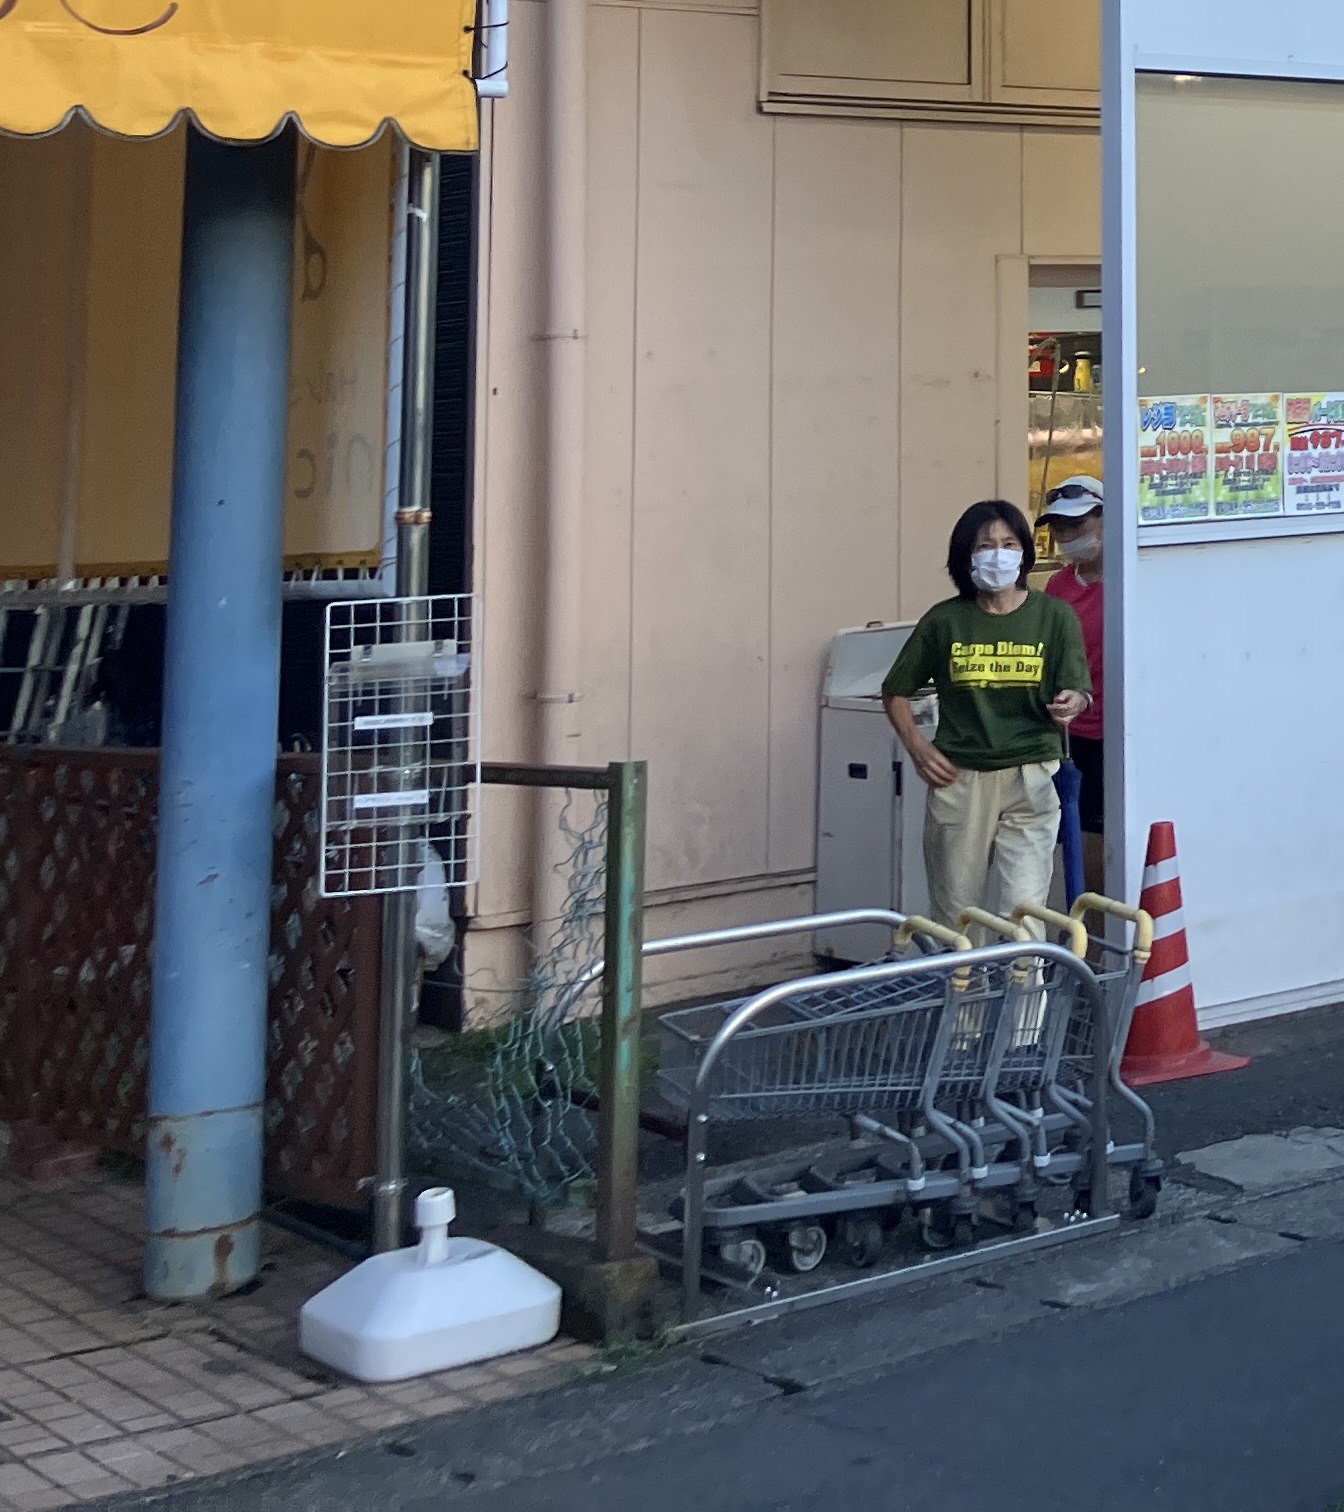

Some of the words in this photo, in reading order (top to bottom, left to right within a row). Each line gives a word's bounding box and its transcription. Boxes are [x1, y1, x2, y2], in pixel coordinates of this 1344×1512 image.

[951, 641, 994, 658] Carpe
[997, 641, 1044, 657] Diem!
[952, 660, 985, 674] Seize
[989, 660, 1011, 673] the
[1016, 661, 1040, 677] Day
